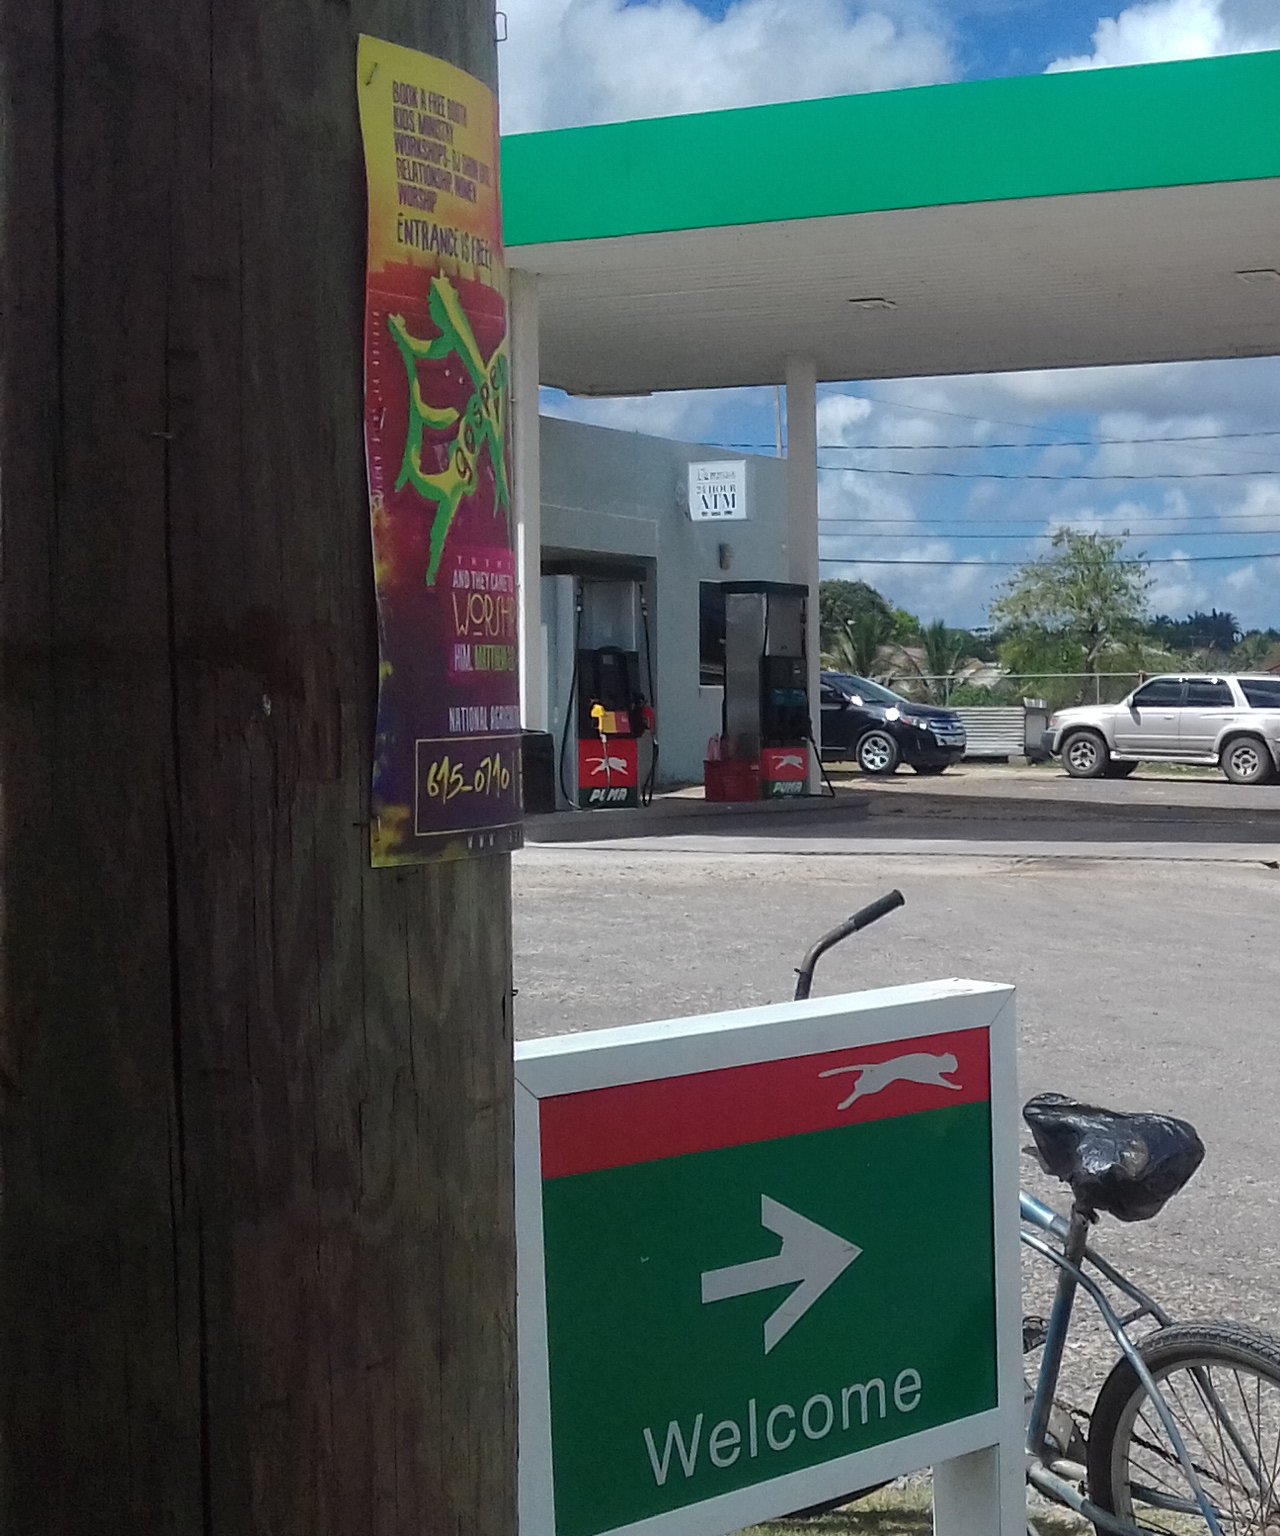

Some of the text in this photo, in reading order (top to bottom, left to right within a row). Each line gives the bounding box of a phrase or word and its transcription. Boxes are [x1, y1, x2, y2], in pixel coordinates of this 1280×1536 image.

[392, 80, 418, 109] BOOK
[420, 88, 427, 111] A
[428, 91, 446, 118] FREE
[393, 106, 415, 133] KIDS
[398, 212, 459, 258] ENTRANCE
[461, 232, 470, 263] IS
[708, 484, 737, 494] HOUR
[453, 569, 470, 589] AND
[470, 571, 490, 591] THEY
[449, 706, 489, 732] NATIONAL
[773, 780, 803, 794] PUMA
[642, 1367, 923, 1487] Welcome
